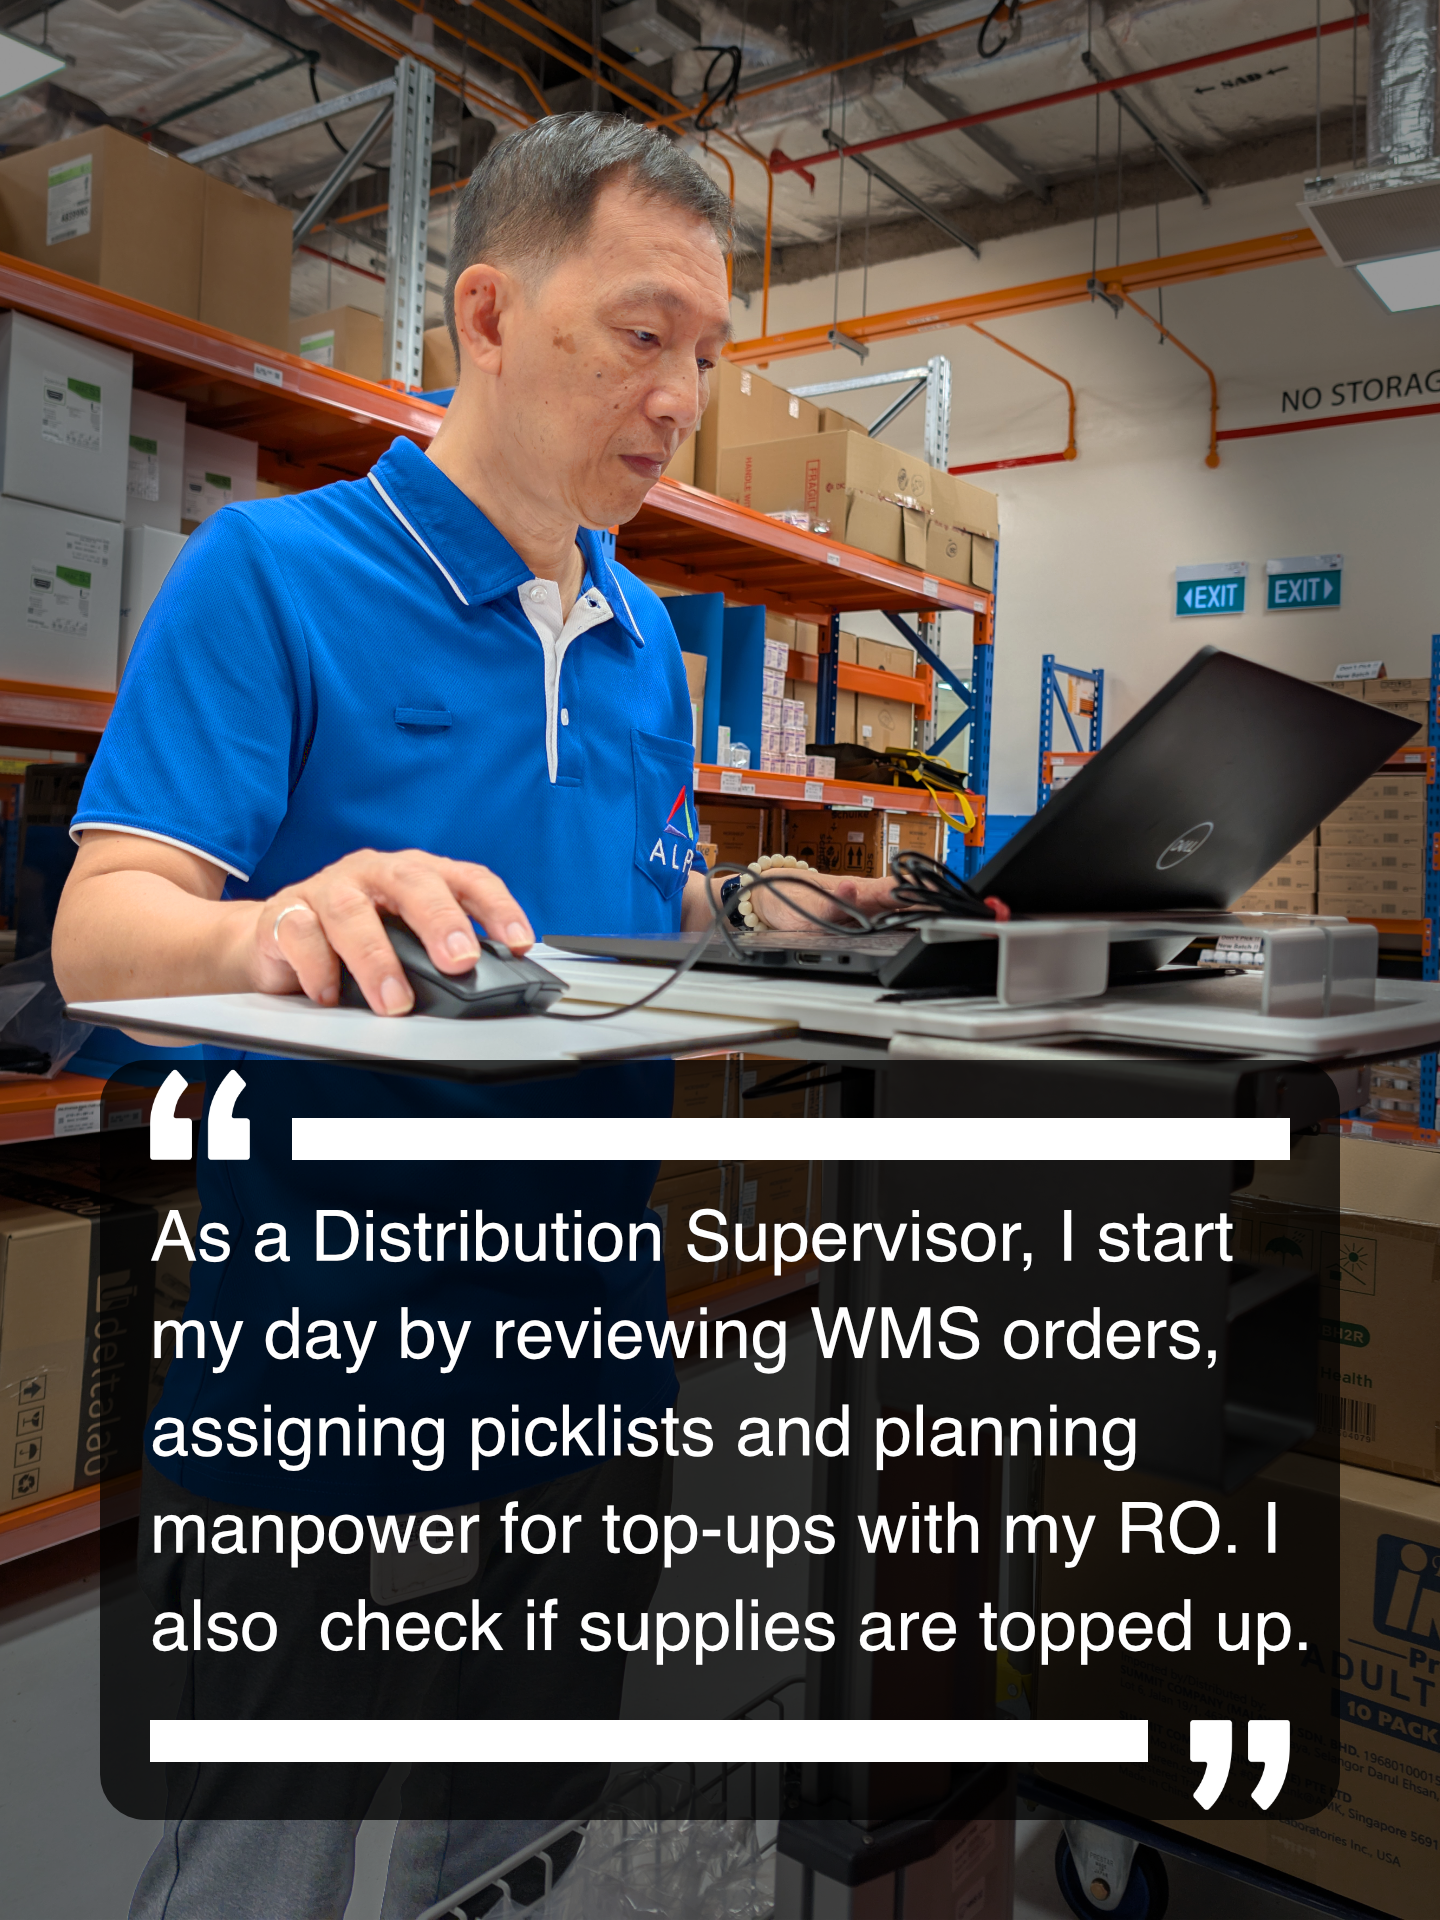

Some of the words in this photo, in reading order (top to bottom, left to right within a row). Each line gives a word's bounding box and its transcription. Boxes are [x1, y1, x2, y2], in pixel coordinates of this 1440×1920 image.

[1282, 387, 1322, 413] NO
[1331, 369, 1440, 406] STORAG
[1194, 584, 1238, 609] EXIT
[1274, 577, 1321, 604] EXIT
[1318, 1324, 1364, 1343] BH2R
[1321, 1366, 1373, 1388] Health
[84, 1316, 127, 1477] deltalab
[1301, 1643, 1435, 1707] ADULT
[1347, 1700, 1372, 1721] 10
[1314, 1749, 1364, 1773] Selangor
[1368, 1766, 1398, 1785] Darul
[1402, 1778, 1439, 1802] Ehsan,
[1330, 1787, 1352, 1803] LTD
[1348, 1808, 1407, 1838] Singapore
[1279, 1812, 1347, 1846] Laboratories
[1377, 1849, 1401, 1867] USA
